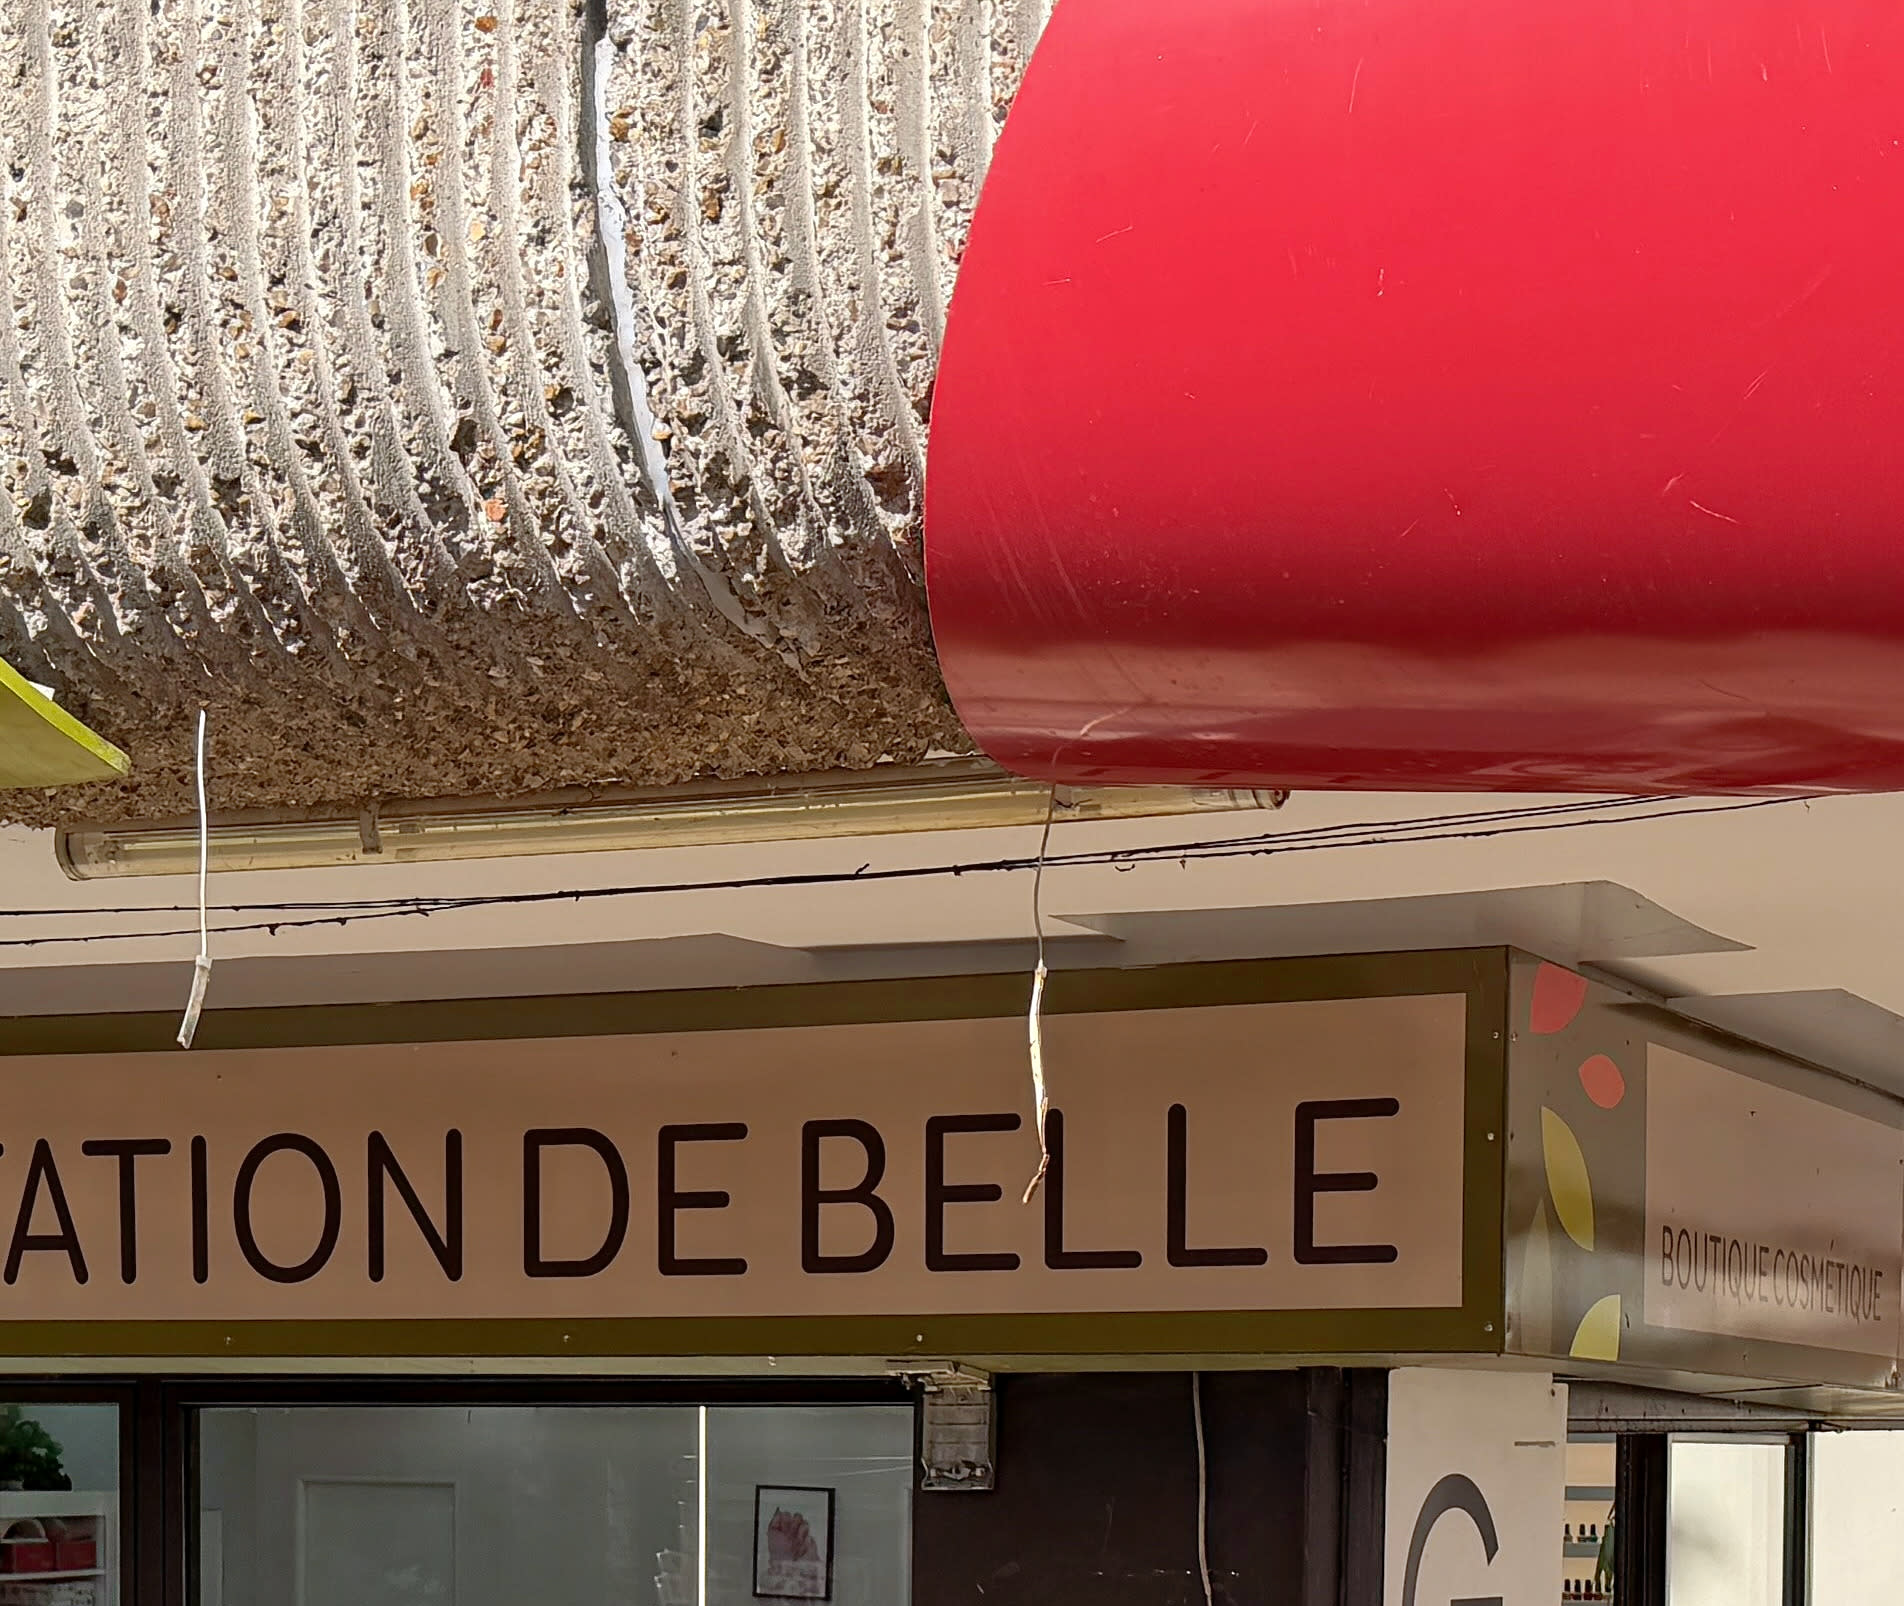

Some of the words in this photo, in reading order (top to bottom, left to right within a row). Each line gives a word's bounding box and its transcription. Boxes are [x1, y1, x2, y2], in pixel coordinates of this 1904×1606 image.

[524, 1121, 749, 1277] DE
[801, 1097, 1400, 1273] BELLE
[1662, 1224, 1770, 1306] BOUTIQUE
[1772, 1239, 1884, 1324] COSMÉTIQUE
